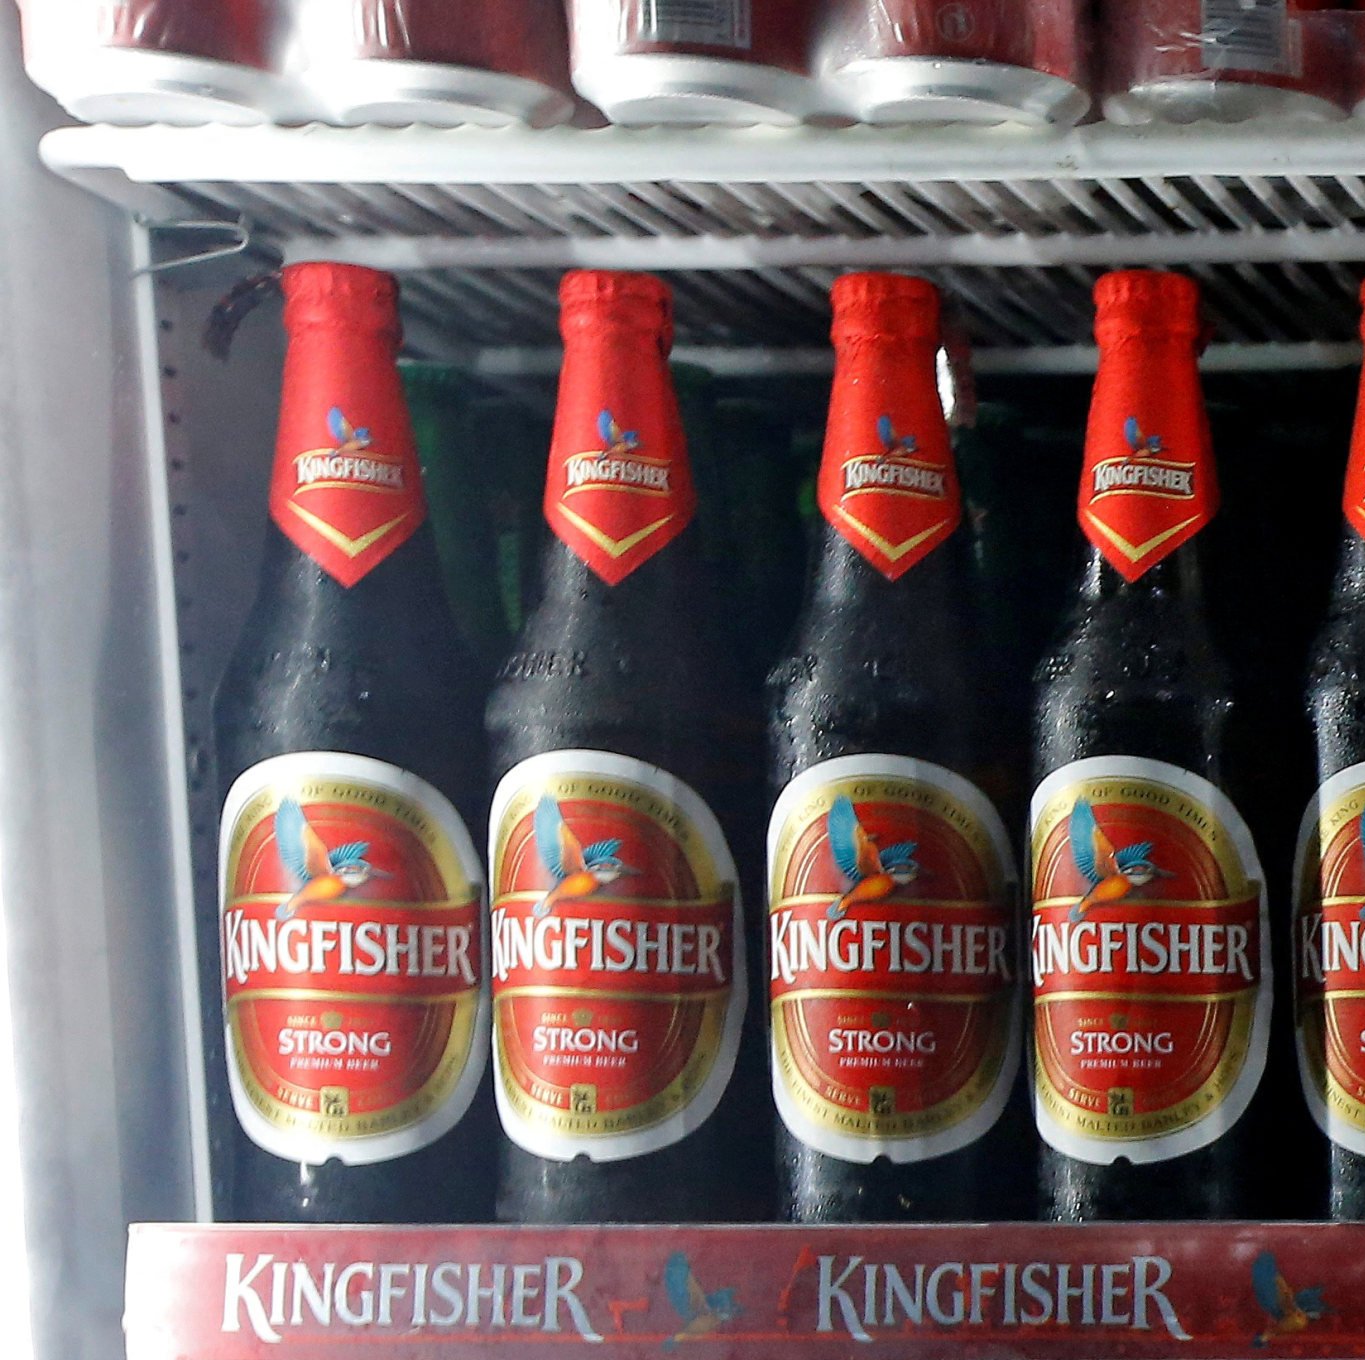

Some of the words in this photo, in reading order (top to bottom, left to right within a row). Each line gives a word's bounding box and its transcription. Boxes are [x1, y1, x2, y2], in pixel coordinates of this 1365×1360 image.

[297, 455, 404, 487] KINGFISHER
[567, 457, 670, 489] KINGFISHER
[845, 462, 946, 495] KINGFISHER
[1094, 464, 1192, 495] KINGFISHER
[224, 910, 477, 984] KINGFISHER
[492, 911, 726, 982] KINGFISHER
[771, 910, 1010, 983] KINGFISHER
[278, 1028, 392, 1055] STRONG
[532, 1025, 638, 1053] STRONG
[827, 1029, 936, 1055] STRONG
[1069, 1030, 1174, 1056] STRONG
[839, 1057, 892, 1068] PREMIUM
[894, 1057, 924, 1068] BEER
[1080, 1059, 1129, 1069] PREMIUM
[1132, 1059, 1161, 1069] BEER
[222, 1253, 603, 1342] KINGFISHER
[817, 1254, 1194, 1342] KINGFISHER
